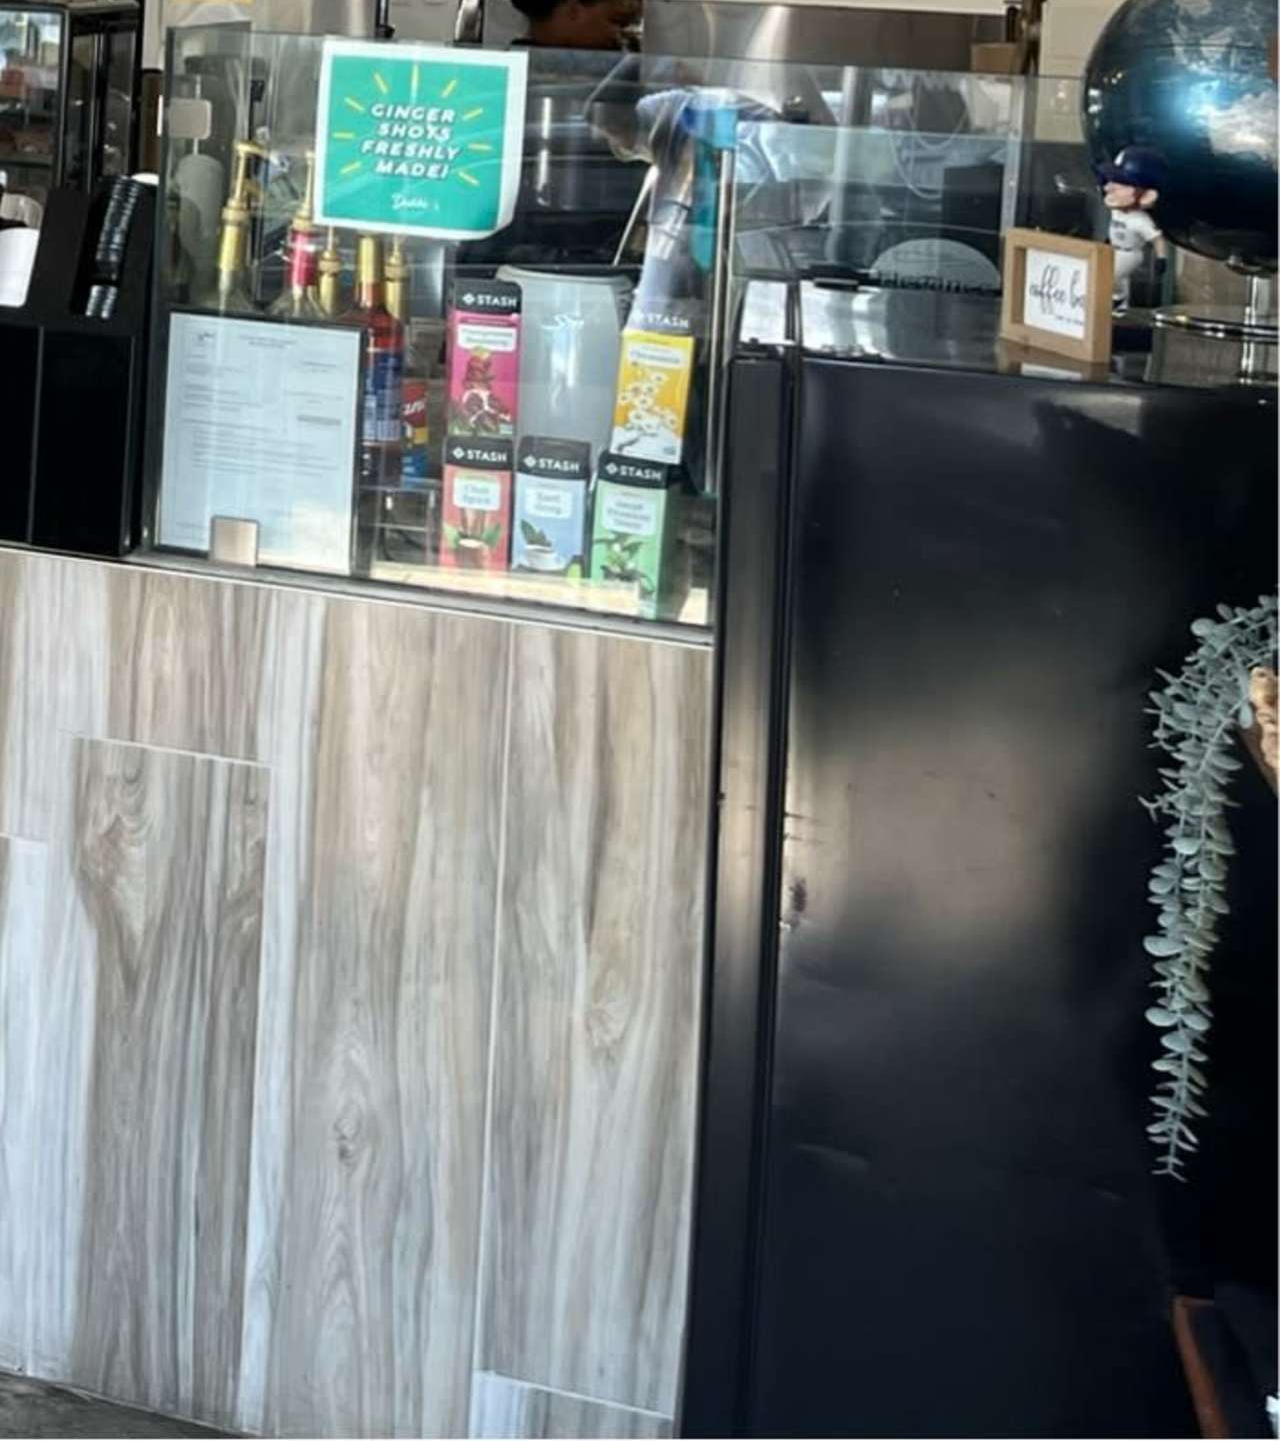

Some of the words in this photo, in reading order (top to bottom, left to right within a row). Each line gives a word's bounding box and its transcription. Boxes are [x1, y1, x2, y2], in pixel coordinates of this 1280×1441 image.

[370, 103, 456, 124] GINGER
[376, 122, 452, 142] SHOTS
[361, 139, 461, 160] FRESHLY
[374, 161, 450, 179] MADE!
[476, 294, 517, 307] STASH
[646, 313, 688, 328] STASH
[466, 449, 507, 461] STASH
[538, 458, 579, 471] STASH
[619, 466, 661, 480] STASH
